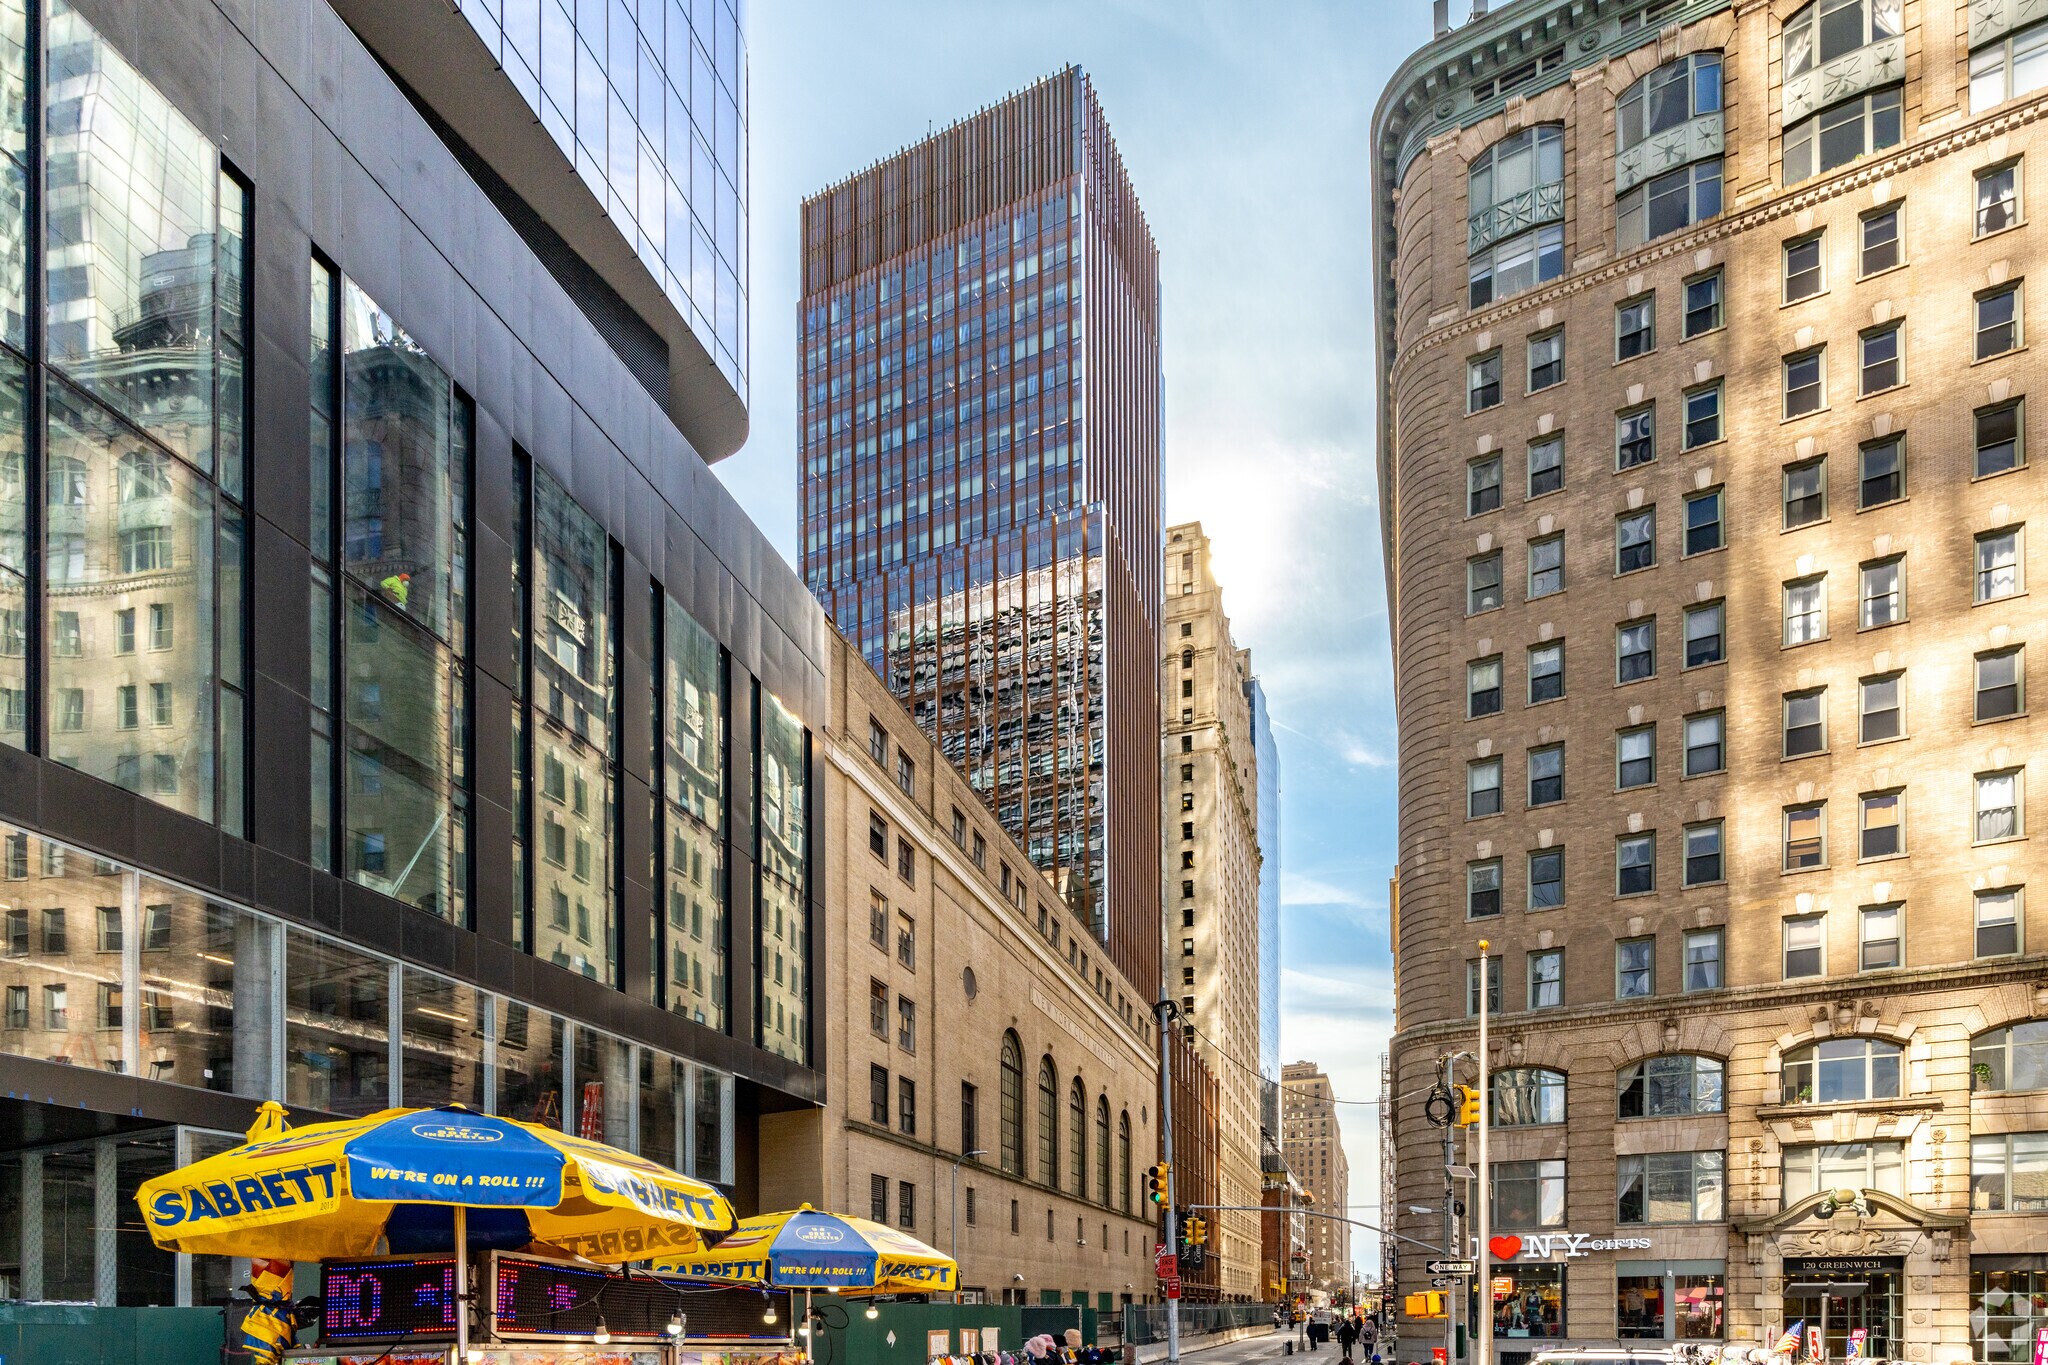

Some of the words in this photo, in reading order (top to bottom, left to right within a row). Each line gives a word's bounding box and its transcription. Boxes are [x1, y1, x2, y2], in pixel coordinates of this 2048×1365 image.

[1054, 1010, 1072, 1033] YORK
[371, 1167, 428, 1183] WE'RE
[433, 1174, 458, 1186] ON
[461, 1175, 474, 1186] A
[479, 1175, 520, 1187] ROLL
[524, 1177, 546, 1188] !!!
[149, 1159, 336, 1227] SABRETT
[1591, 1238, 1651, 1250] GIFTS
[779, 1266, 807, 1275] WE'RE
[809, 1266, 822, 1275] ON
[823, 1267, 832, 1275] A
[833, 1267, 853, 1276] ROLL
[856, 1268, 866, 1276] !!!
[1818, 1261, 1881, 1269] GREENWICH
